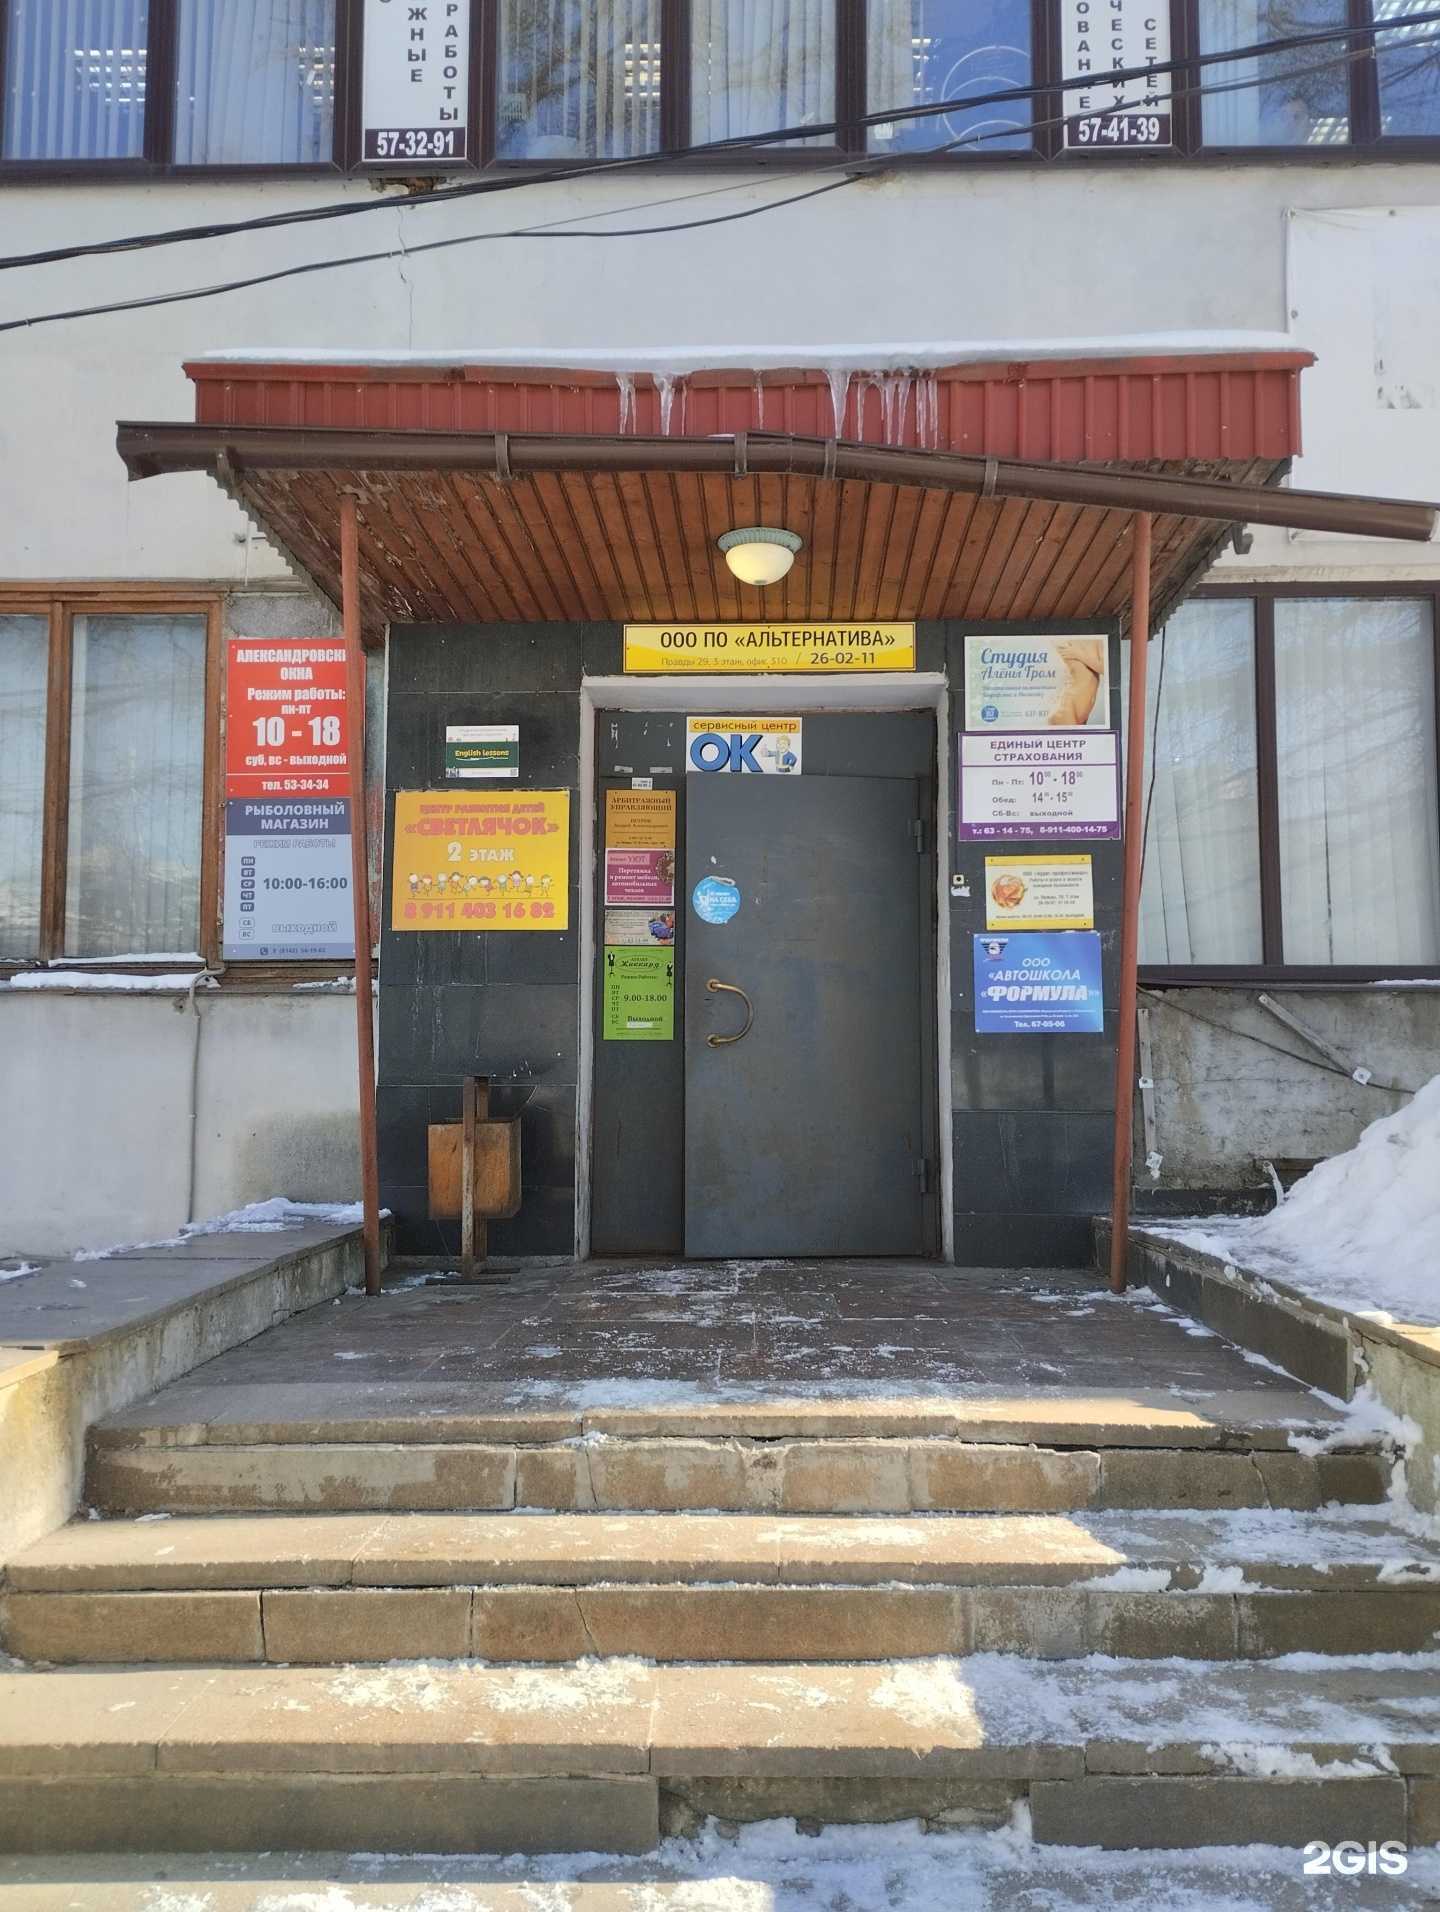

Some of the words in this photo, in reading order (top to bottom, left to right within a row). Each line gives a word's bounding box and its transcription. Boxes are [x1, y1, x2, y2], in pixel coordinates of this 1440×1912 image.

[408, 0, 428, 82] ЖНЫЕ
[440, 3, 459, 121] РАБОТЫ
[1076, 2, 1091, 109] ОВАНЕ
[1142, 18, 1159, 107] СЕТЕЙ
[1078, 117, 1160, 142] 57-41-39
[377, 131, 455, 156] 57-32-91
[660, 631, 697, 649] ООО
[703, 631, 728, 648] ПО
[735, 630, 896, 648] «АЛЬТЕРНАТИВА»
[810, 652, 876, 665] 26-02-11
[981, 647, 1048, 669] Студия
[280, 667, 313, 681] ОКНА
[247, 687, 292, 701] Режим
[294, 687, 347, 701] работы:
[281, 704, 312, 715] пн-пт
[252, 716, 285, 746] 10
[307, 716, 341, 746] 18
[693, 719, 757, 734] сервисный
[761, 721, 798, 734] центр
[990, 740, 1043, 750] ЕДИНЫЙ
[1046, 739, 1087, 750] ЦЕНТР
[268, 756, 282, 765] вс
[289, 753, 347, 765] выходной
[455, 749, 481, 758] English
[690, 732, 764, 773] ОК
[994, 752, 1083, 762] СТРАХОВАНИЯ
[262, 780, 283, 790] тел.
[284, 779, 330, 790] 53-34-34
[245, 801, 345, 816] РЫБОЛОВНЫЙ
[261, 818, 329, 830] МАГАЗИН
[404, 816, 560, 836] «СВЕТЛЯЧОК»
[447, 841, 463, 862] 2
[263, 877, 348, 890] 10:00-16:00
[404, 902, 417, 919] 8
[421, 902, 455, 919] 911
[503, 902, 526, 919] 16
[530, 902, 555, 919] 82
[1022, 957, 1051, 968] ООО
[988, 969, 1081, 982] «АВТОШКОЛА
[623, 994, 667, 1002] 9.00-18.00
